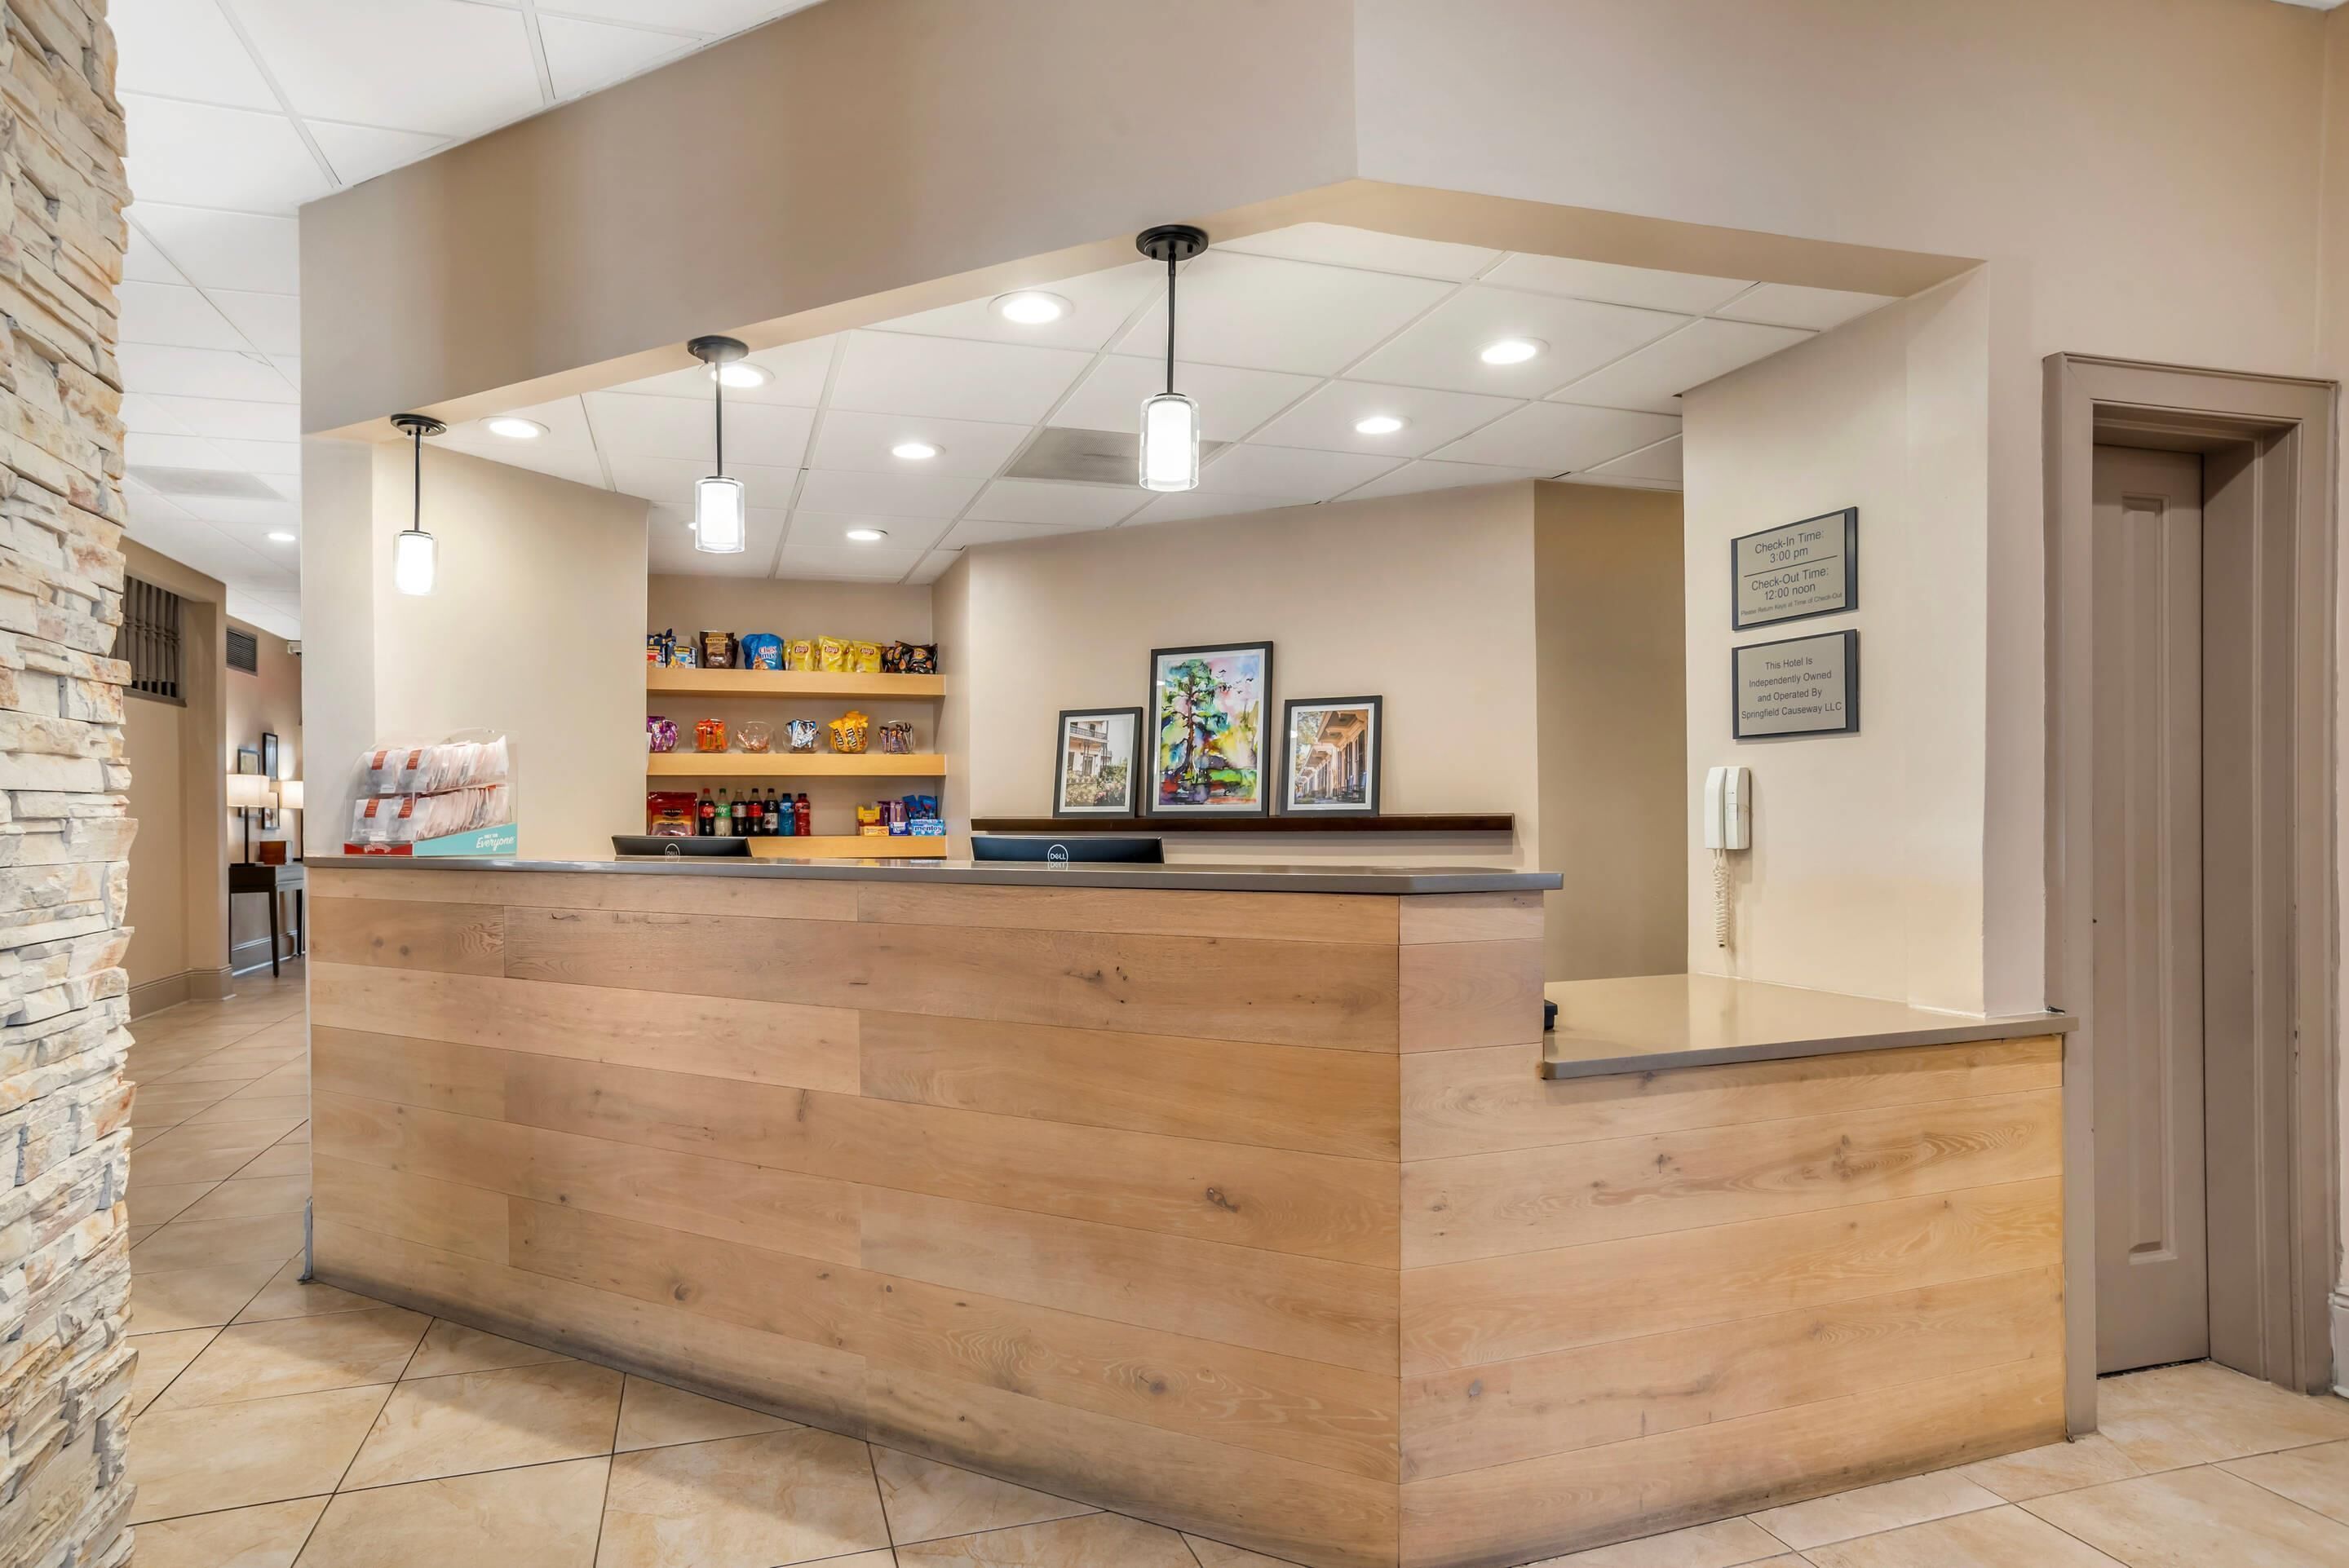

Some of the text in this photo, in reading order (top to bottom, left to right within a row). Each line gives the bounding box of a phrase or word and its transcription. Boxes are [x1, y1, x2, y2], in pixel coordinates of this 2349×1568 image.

[1755, 530, 1825, 554] Check-In Time:
[1770, 547, 1808, 563] 3:00 pm
[1751, 568, 1829, 590] Check-Out Time:
[1765, 583, 1816, 600] 12:00 noon
[1766, 656, 1813, 670] This Hotel Is
[1749, 670, 1832, 688] Independently Owned
[1758, 687, 1822, 703] and Operated By
[1741, 701, 1842, 720] Springfield Causeway LLC
[914, 824, 942, 833] mentos
[476, 835, 515, 852] Everyone
